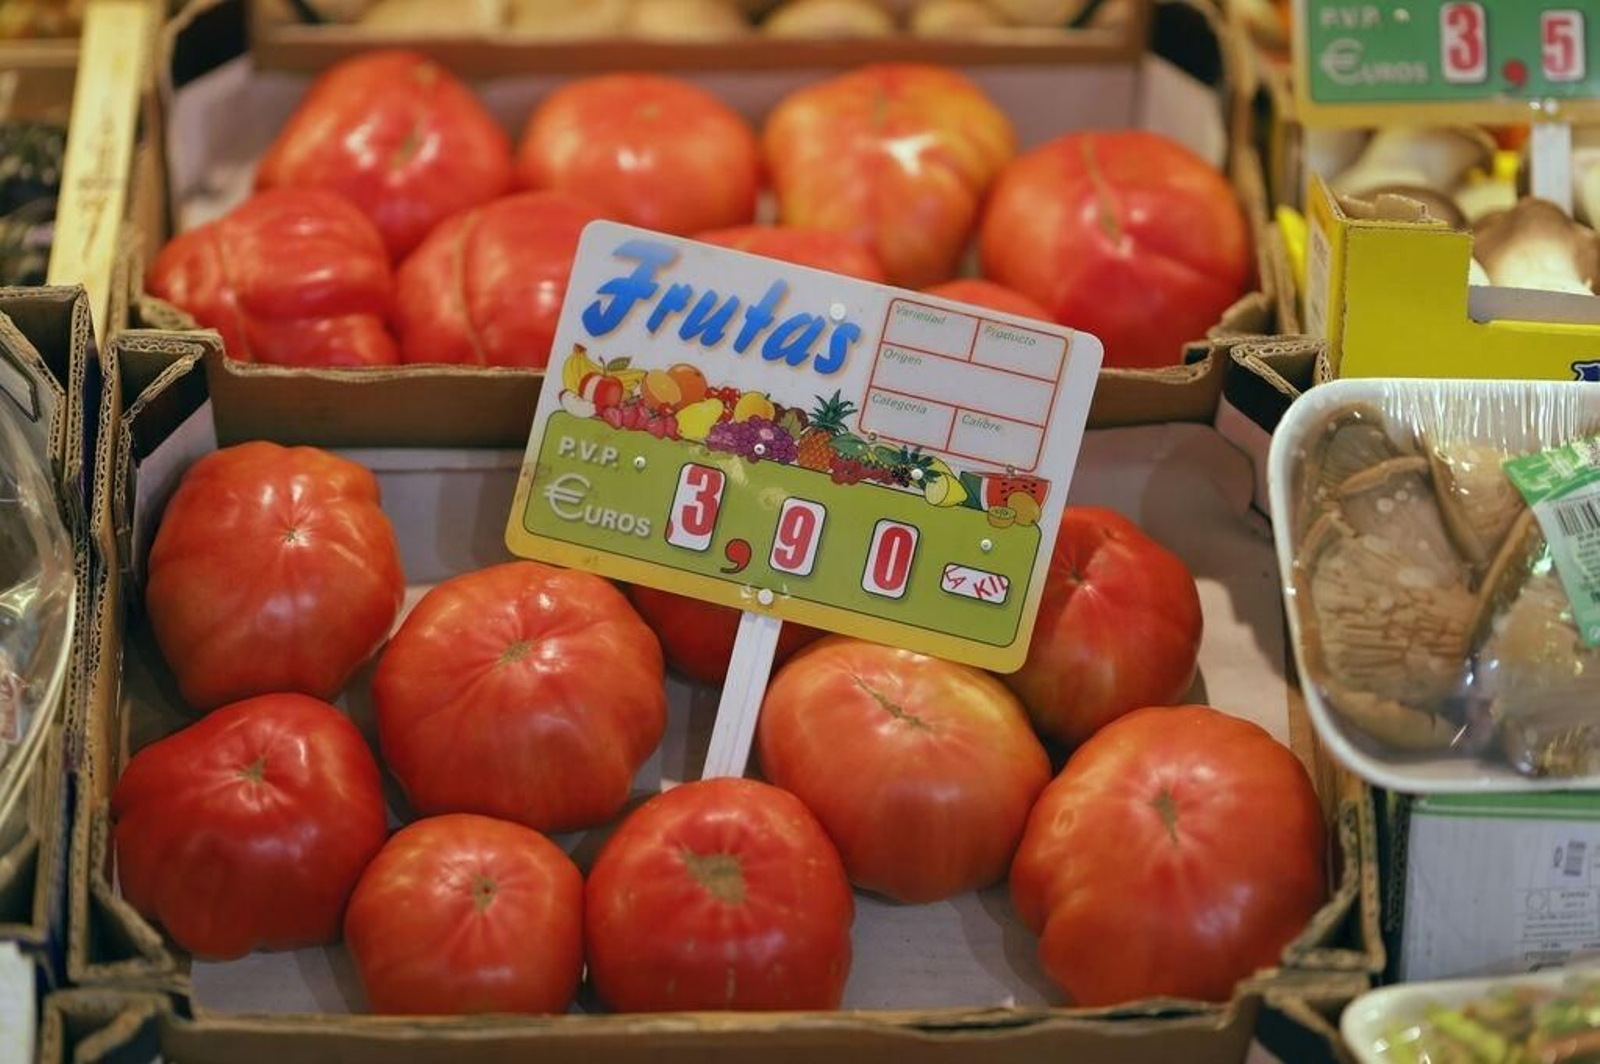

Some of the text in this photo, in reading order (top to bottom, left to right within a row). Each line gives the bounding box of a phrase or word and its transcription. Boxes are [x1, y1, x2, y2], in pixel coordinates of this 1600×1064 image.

[582, 240, 862, 375] Frutas
[896, 304, 947, 325] Variedad
[984, 325, 1037, 347] Producto
[883, 349, 923, 367] Origen
[559, 436, 619, 467] P.V.P.
